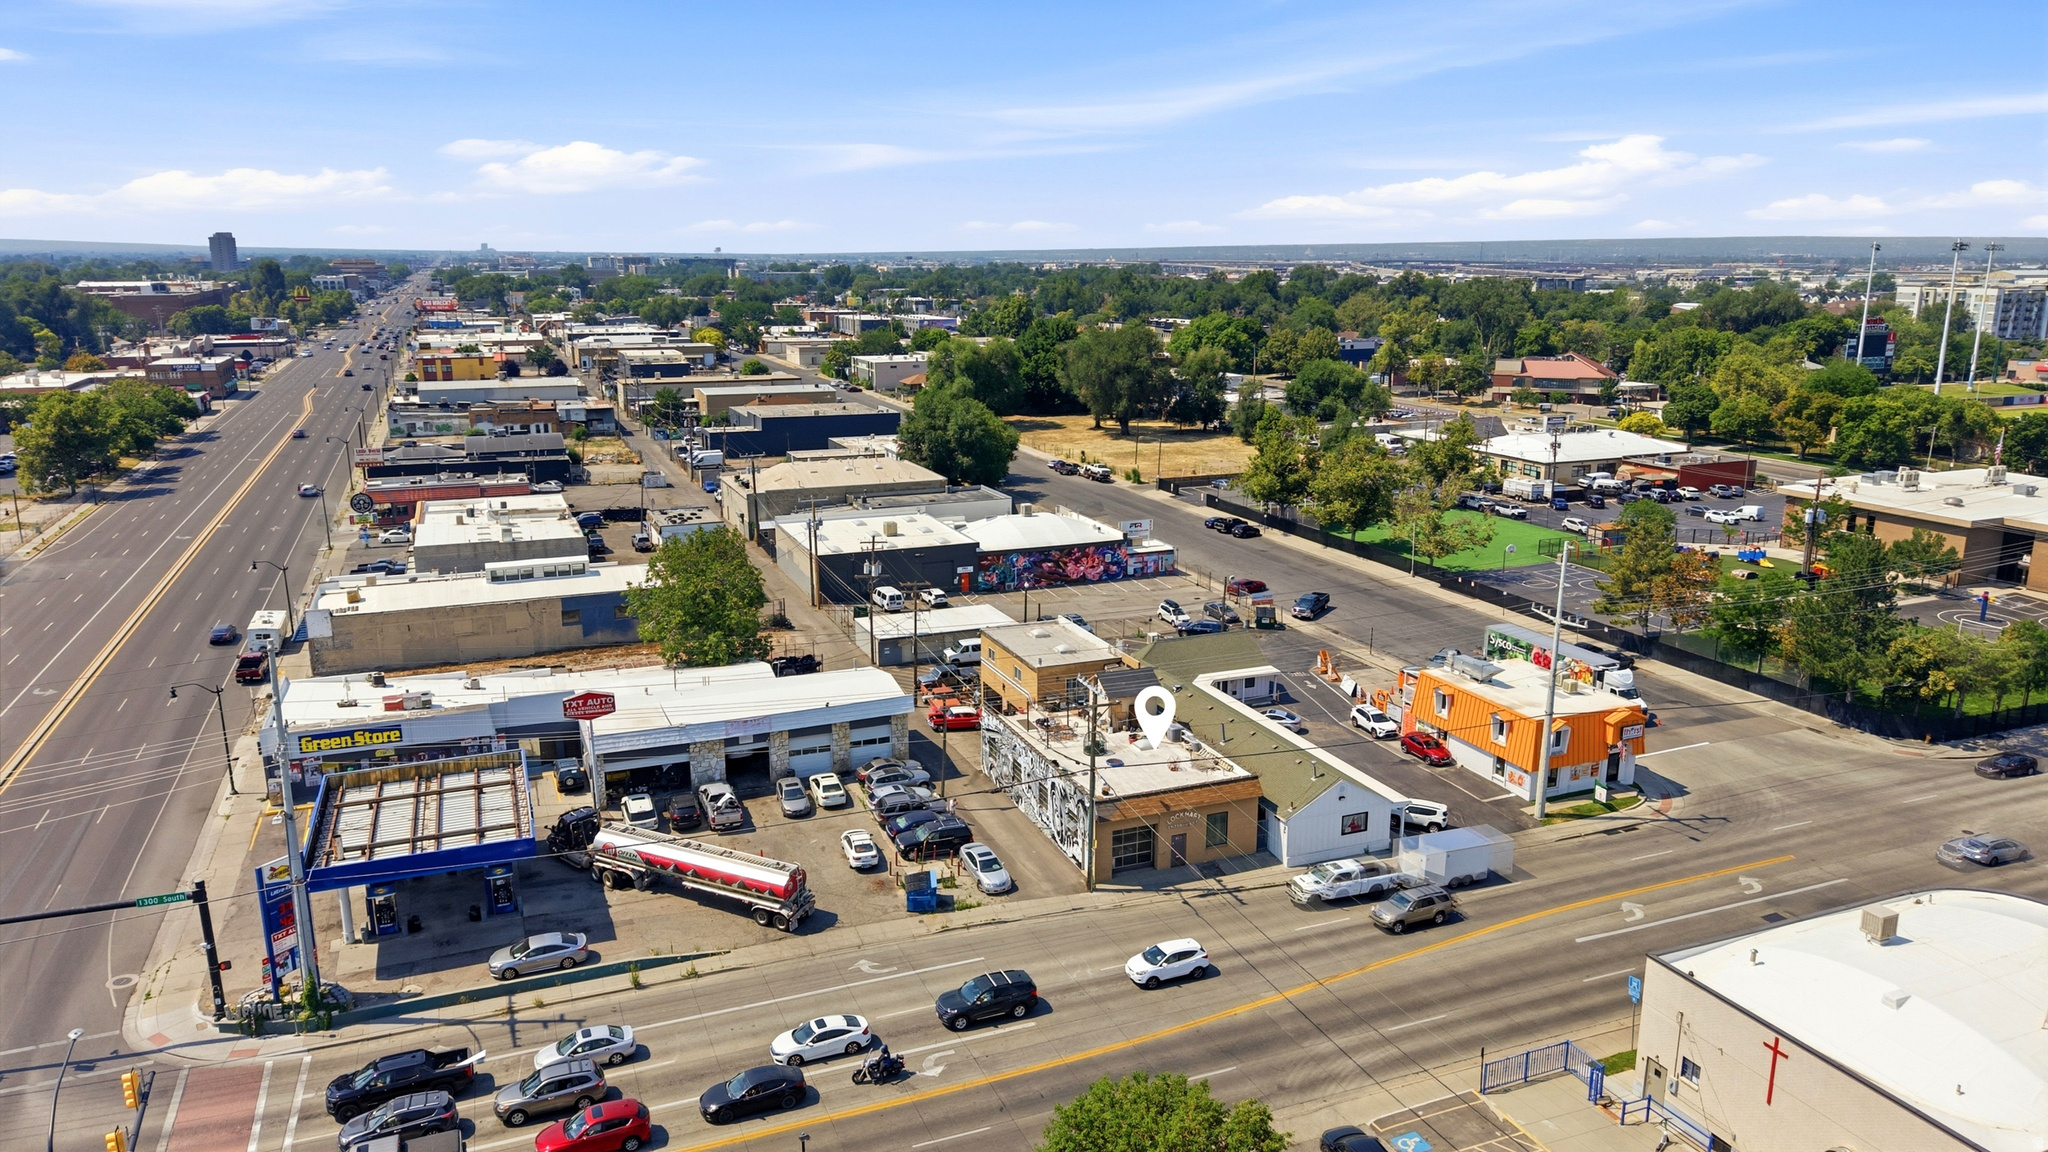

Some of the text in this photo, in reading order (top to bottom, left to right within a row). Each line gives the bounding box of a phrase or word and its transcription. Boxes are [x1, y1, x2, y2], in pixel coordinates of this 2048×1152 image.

[1489, 633, 1512, 650] Sysco
[564, 696, 614, 708] TXT AUTO
[301, 729, 401, 752] Green Store
[138, 894, 185, 906] 1300 South
[273, 930, 288, 940] TXT
